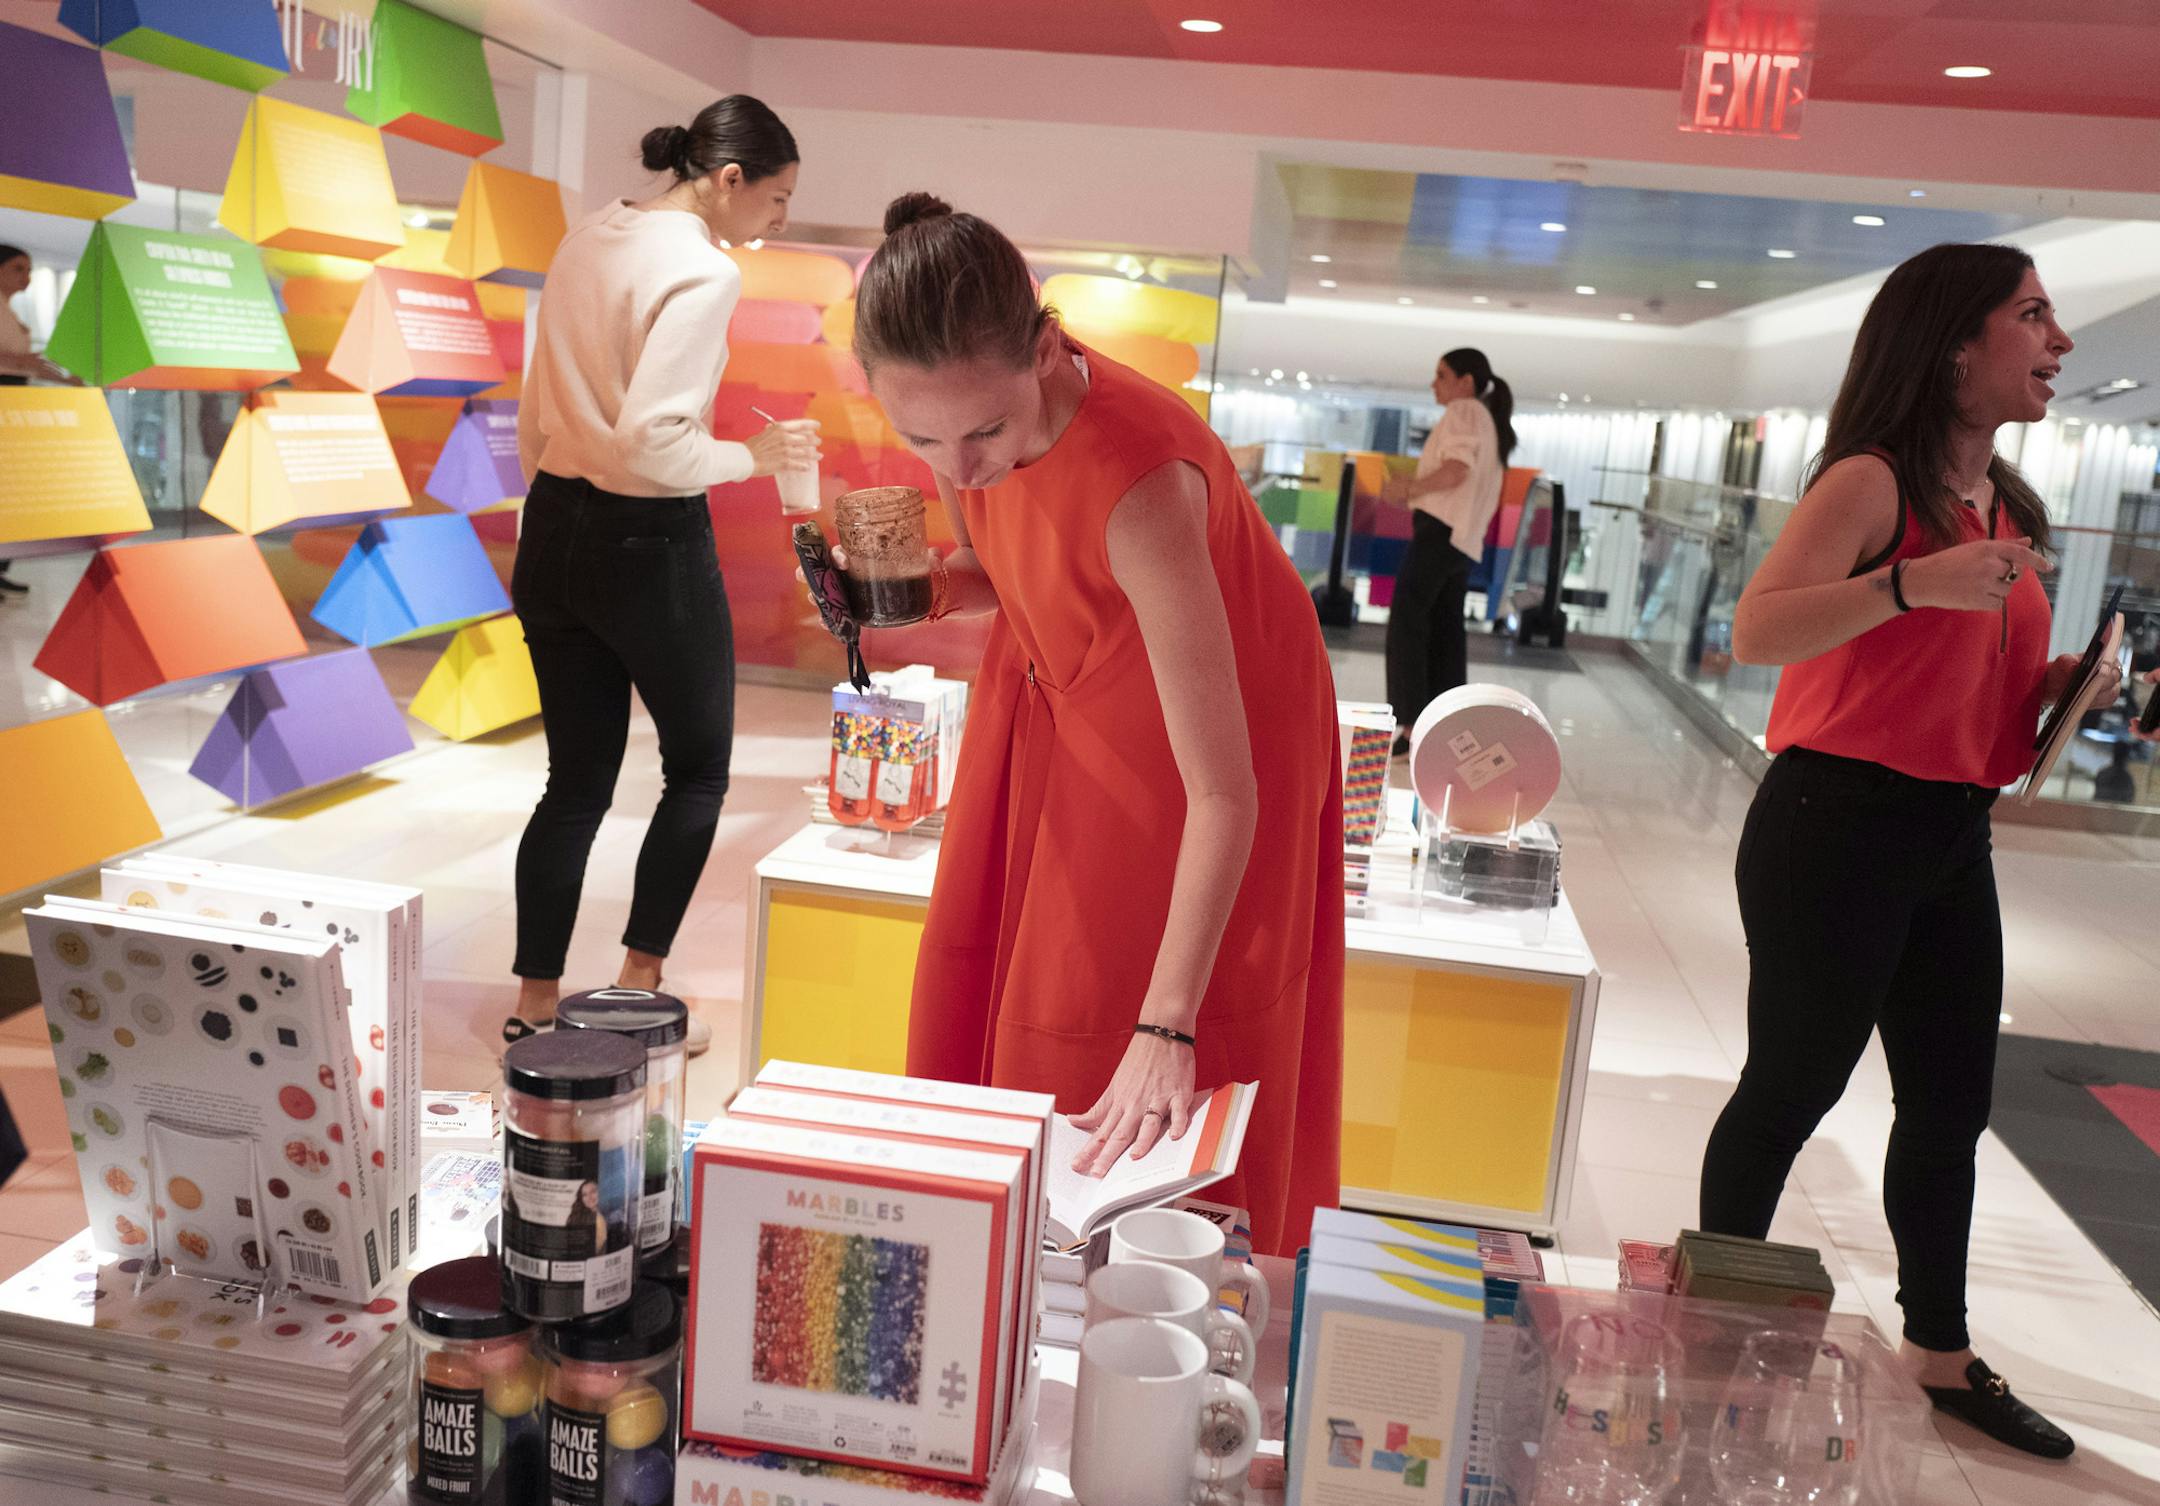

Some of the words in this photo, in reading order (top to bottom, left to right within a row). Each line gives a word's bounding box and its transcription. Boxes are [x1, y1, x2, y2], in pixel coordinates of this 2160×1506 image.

[1695, 51, 1800, 131] EXIT
[787, 1189, 904, 1222] MARBLES
[424, 1397, 475, 1429] AMAZE
[424, 1422, 476, 1456] BALLS
[551, 1417, 598, 1453] AMAZE
[550, 1442, 598, 1481] BALLS
[426, 1475, 448, 1491] MIXED
[448, 1480, 471, 1493] FRUIT
